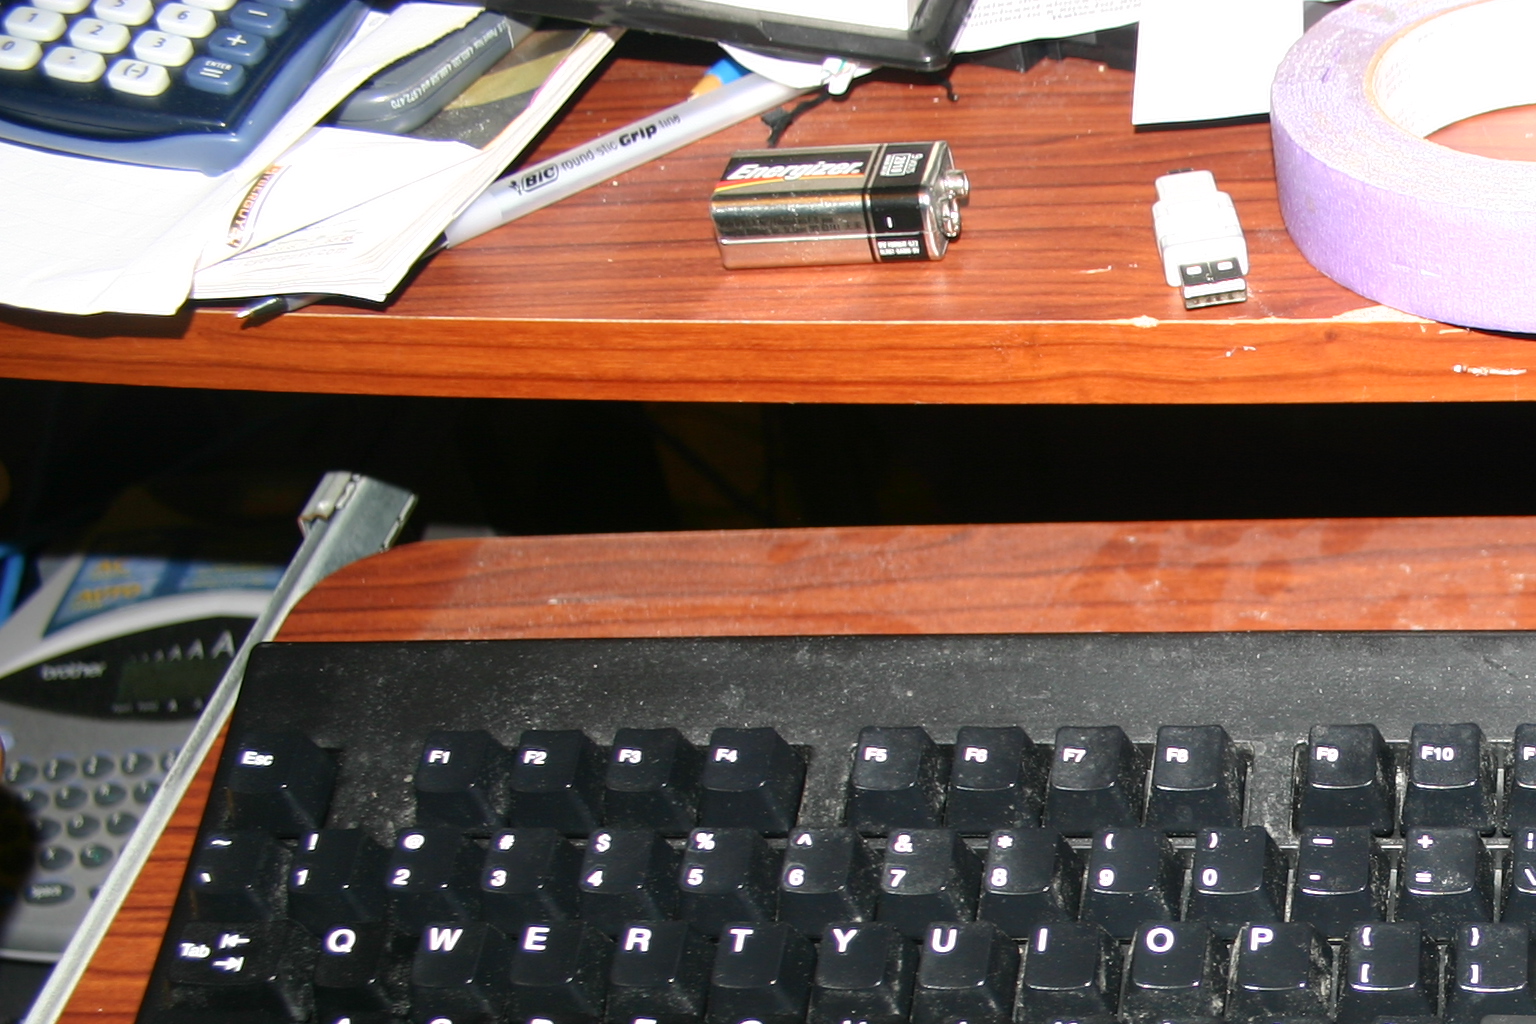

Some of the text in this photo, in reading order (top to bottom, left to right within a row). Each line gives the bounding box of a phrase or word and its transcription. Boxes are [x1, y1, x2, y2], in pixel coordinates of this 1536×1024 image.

[177, 9, 190, 21] 6
[89, 24, 104, 37] 2
[152, 37, 167, 49] 3
[204, 59, 233, 72] ENTER
[523, 112, 682, 190] BIC round stic Grip fine
[211, 630, 236, 660] A
[41, 662, 107, 682] brother
[240, 750, 274, 766] Esc
[428, 749, 451, 764] F1
[523, 750, 548, 765] F2
[618, 748, 642, 764] F3
[714, 748, 738, 763] F4
[864, 746, 888, 763] F5
[964, 746, 989, 763] F6
[1062, 747, 1087, 763] F7
[1165, 747, 1190, 764] F8
[1315, 746, 1340, 763] F9
[1420, 745, 1455, 762] F10
[403, 834, 425, 850] @
[594, 833, 612, 853] $
[694, 832, 716, 851] %
[893, 834, 914, 853] &
[296, 869, 309, 886] 1
[392, 868, 411, 886] 2
[489, 869, 507, 887] 3
[586, 870, 604, 887] 4
[686, 868, 704, 886] 5
[787, 868, 805, 887] 6
[889, 868, 907, 888] 7
[989, 867, 1008, 887] 8
[1098, 868, 1115, 887] 9
[1201, 868, 1219, 887] 0
[326, 928, 356, 953] Q
[429, 927, 464, 952] W
[523, 926, 551, 951] E
[624, 927, 652, 952] R
[729, 928, 754, 953] T
[832, 928, 858, 953] Y
[930, 927, 958, 953] U
[1036, 927, 1049, 952] I
[1145, 927, 1175, 953] O
[1249, 926, 1274, 952] P
[180, 942, 211, 959] Tab
